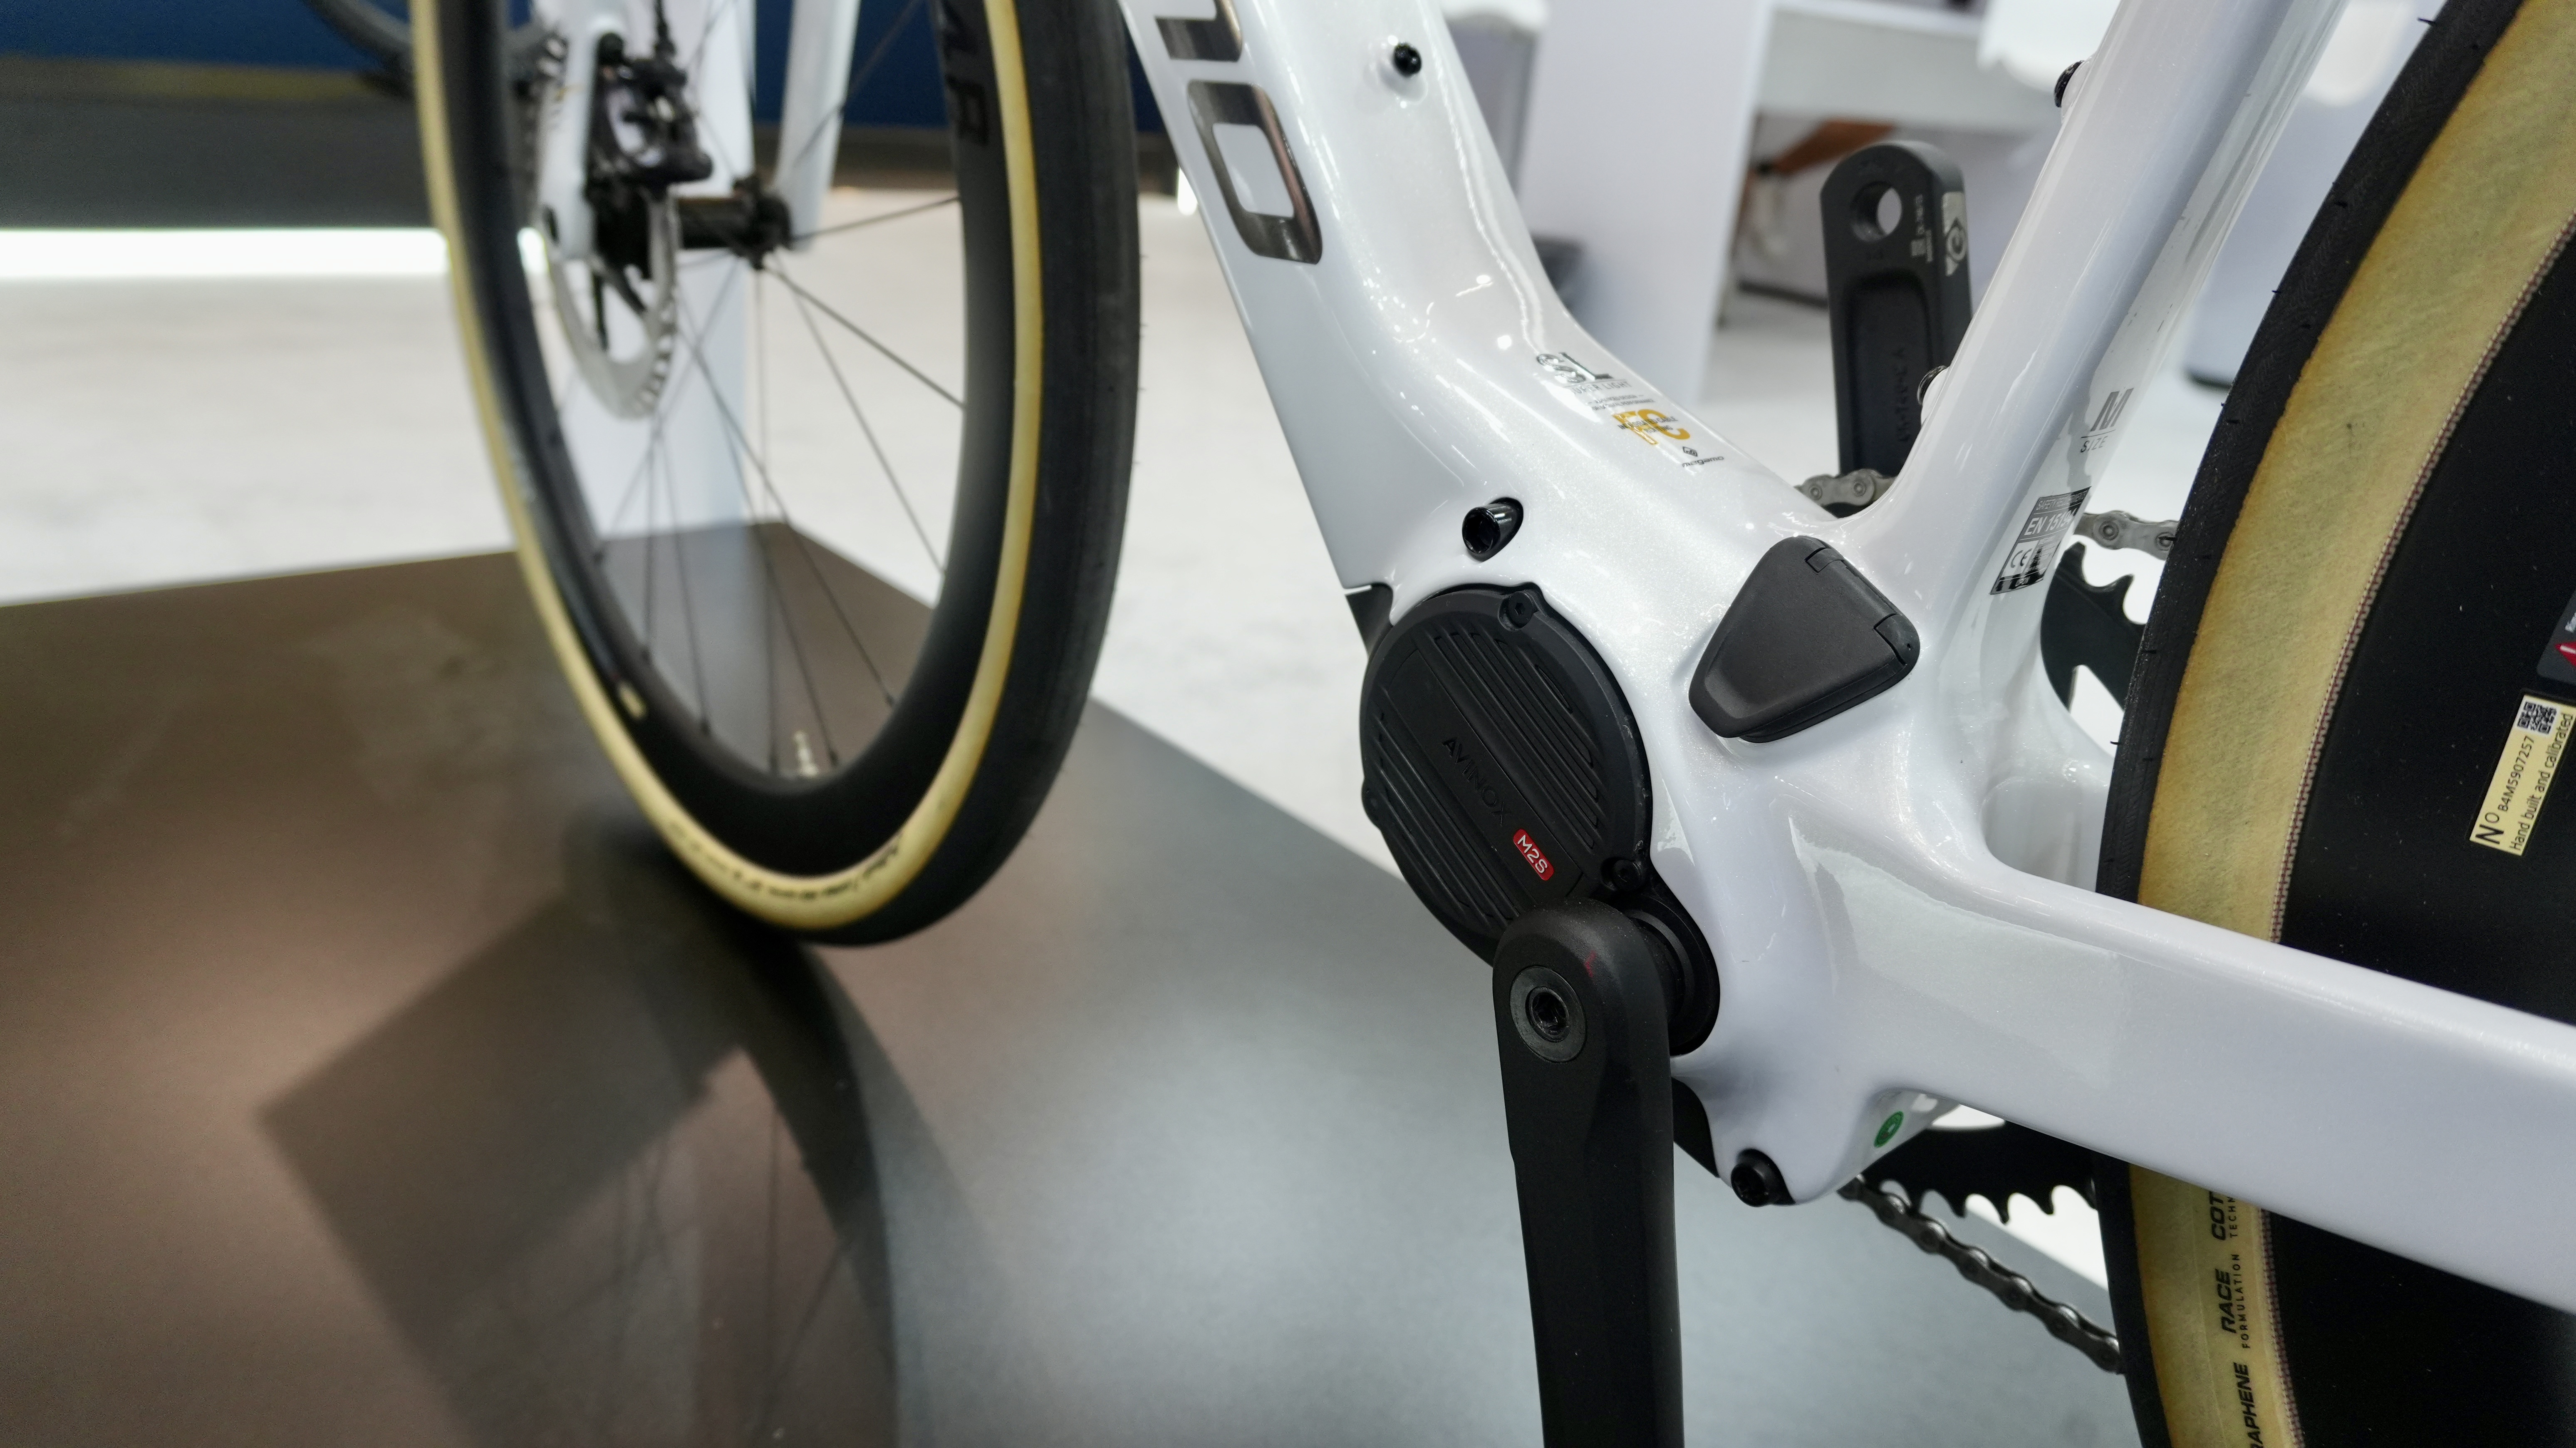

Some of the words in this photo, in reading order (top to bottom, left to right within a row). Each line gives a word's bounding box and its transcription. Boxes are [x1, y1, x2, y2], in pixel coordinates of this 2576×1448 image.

[1536, 352, 1615, 383] SL
[1603, 381, 1632, 390] LIGHT
[2090, 387, 2134, 432] M
[1682, 456, 1724, 468] megamo
[2080, 436, 2108, 453] SIZE
[2024, 516, 2048, 536] EN
[1442, 737, 1512, 827] AVINOX
[2498, 735, 2535, 812] B4M5907257
[2509, 821, 2531, 851] Hand
[2520, 793, 2542, 820] built
[2535, 770, 2551, 793] and
[2544, 712, 2574, 769] calibrated
[1517, 835, 1548, 874] M2S
[2215, 1268, 2237, 1334] RACE
[2232, 1253, 2251, 1349] FORMULATION
